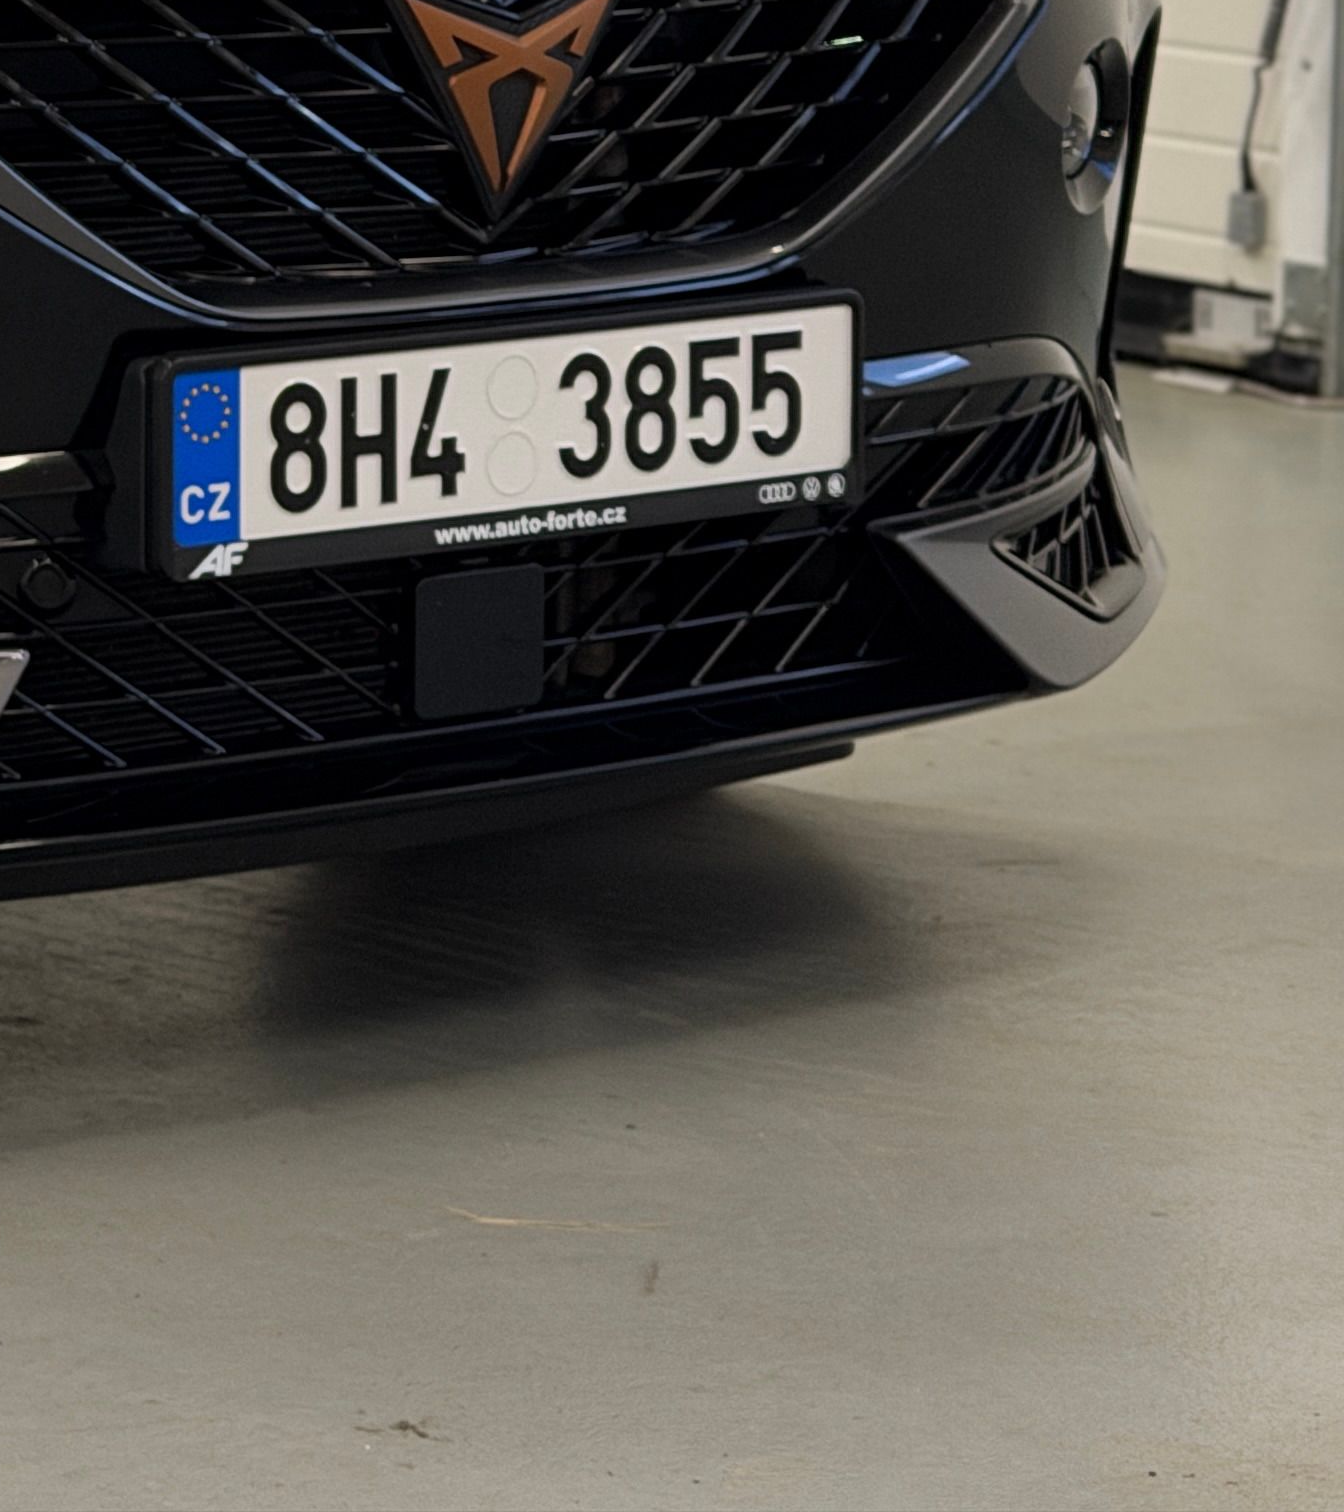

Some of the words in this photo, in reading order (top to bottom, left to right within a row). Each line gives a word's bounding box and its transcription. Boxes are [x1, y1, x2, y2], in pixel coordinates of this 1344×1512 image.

[270, 367, 466, 513] 8H4
[558, 330, 803, 478] 3855
[180, 481, 231, 525] CZ
[434, 506, 627, 545] www.auto-forte.cz
[188, 541, 249, 580] AF
